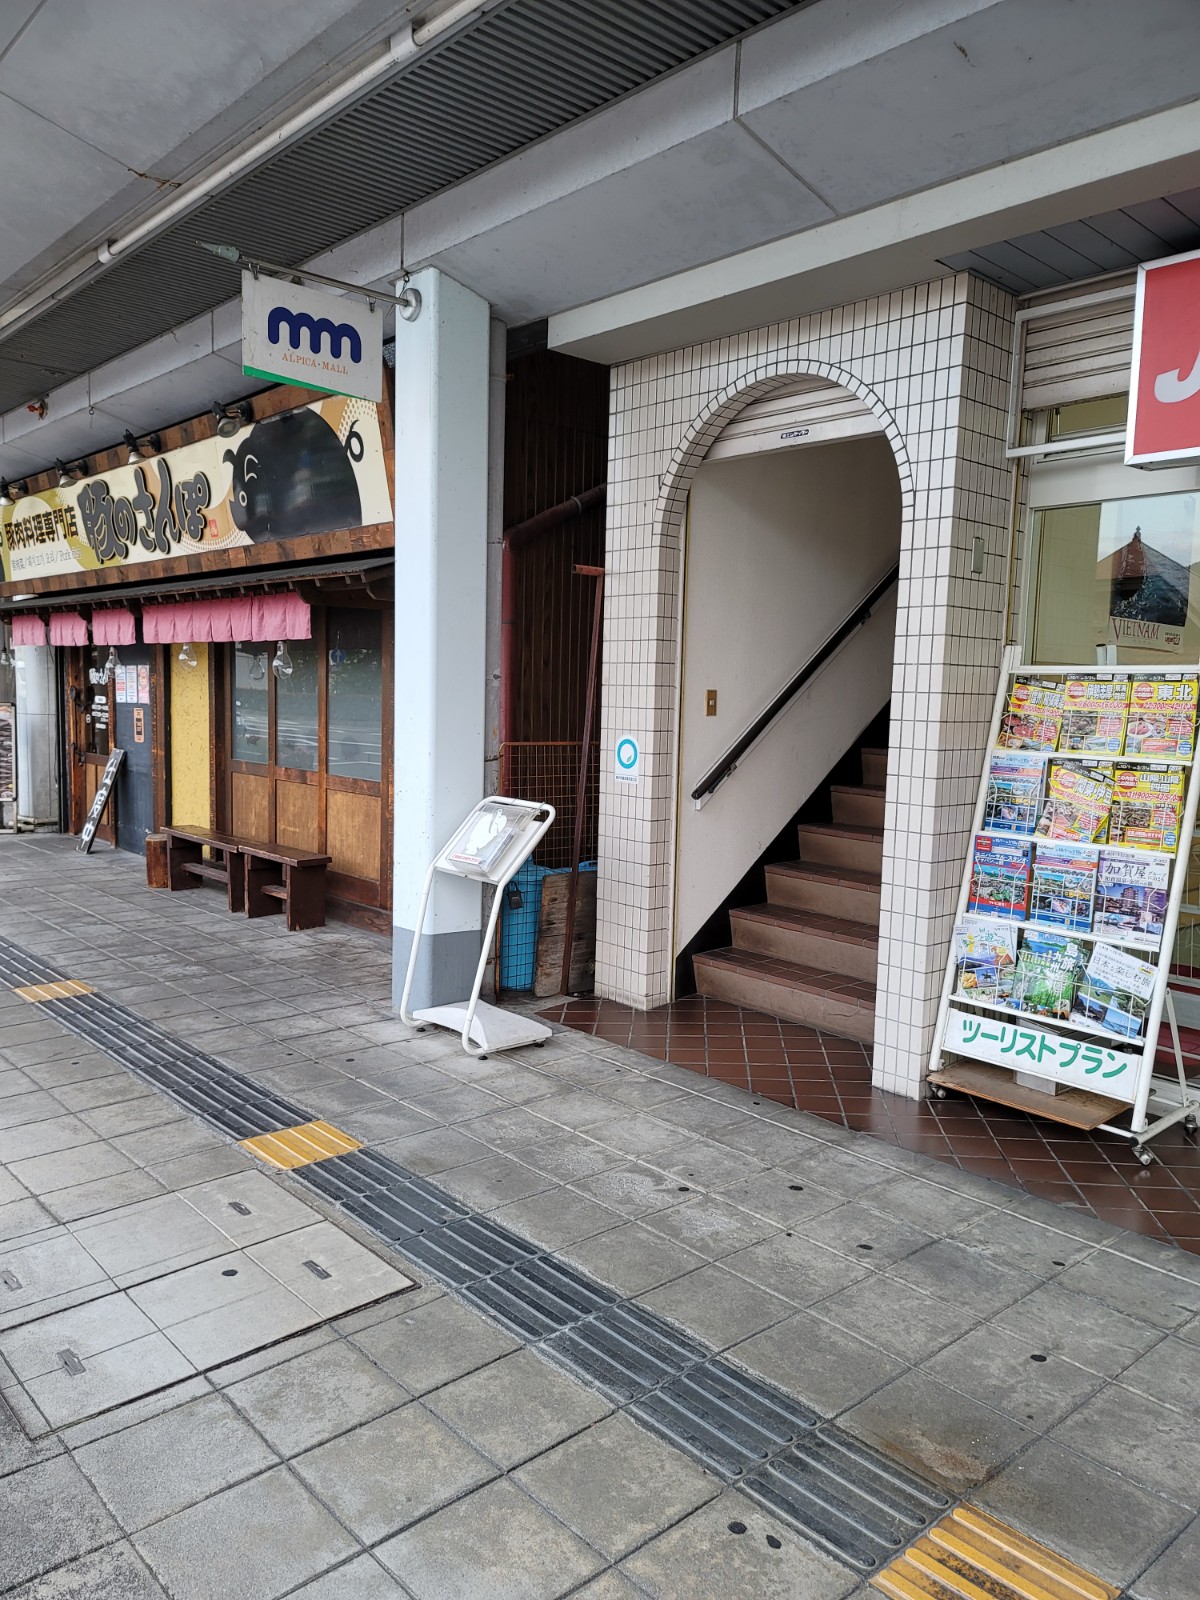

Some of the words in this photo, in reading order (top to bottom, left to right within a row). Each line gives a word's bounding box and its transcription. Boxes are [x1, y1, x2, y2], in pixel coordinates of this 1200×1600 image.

[77, 458, 210, 563] 豚のさんぽ
[1112, 618, 1160, 641] VIETNAM
[1157, 684, 1193, 701] 東北
[1105, 863, 1146, 878] 加賀屋
[962, 1020, 1127, 1078] ツーリストプラン
